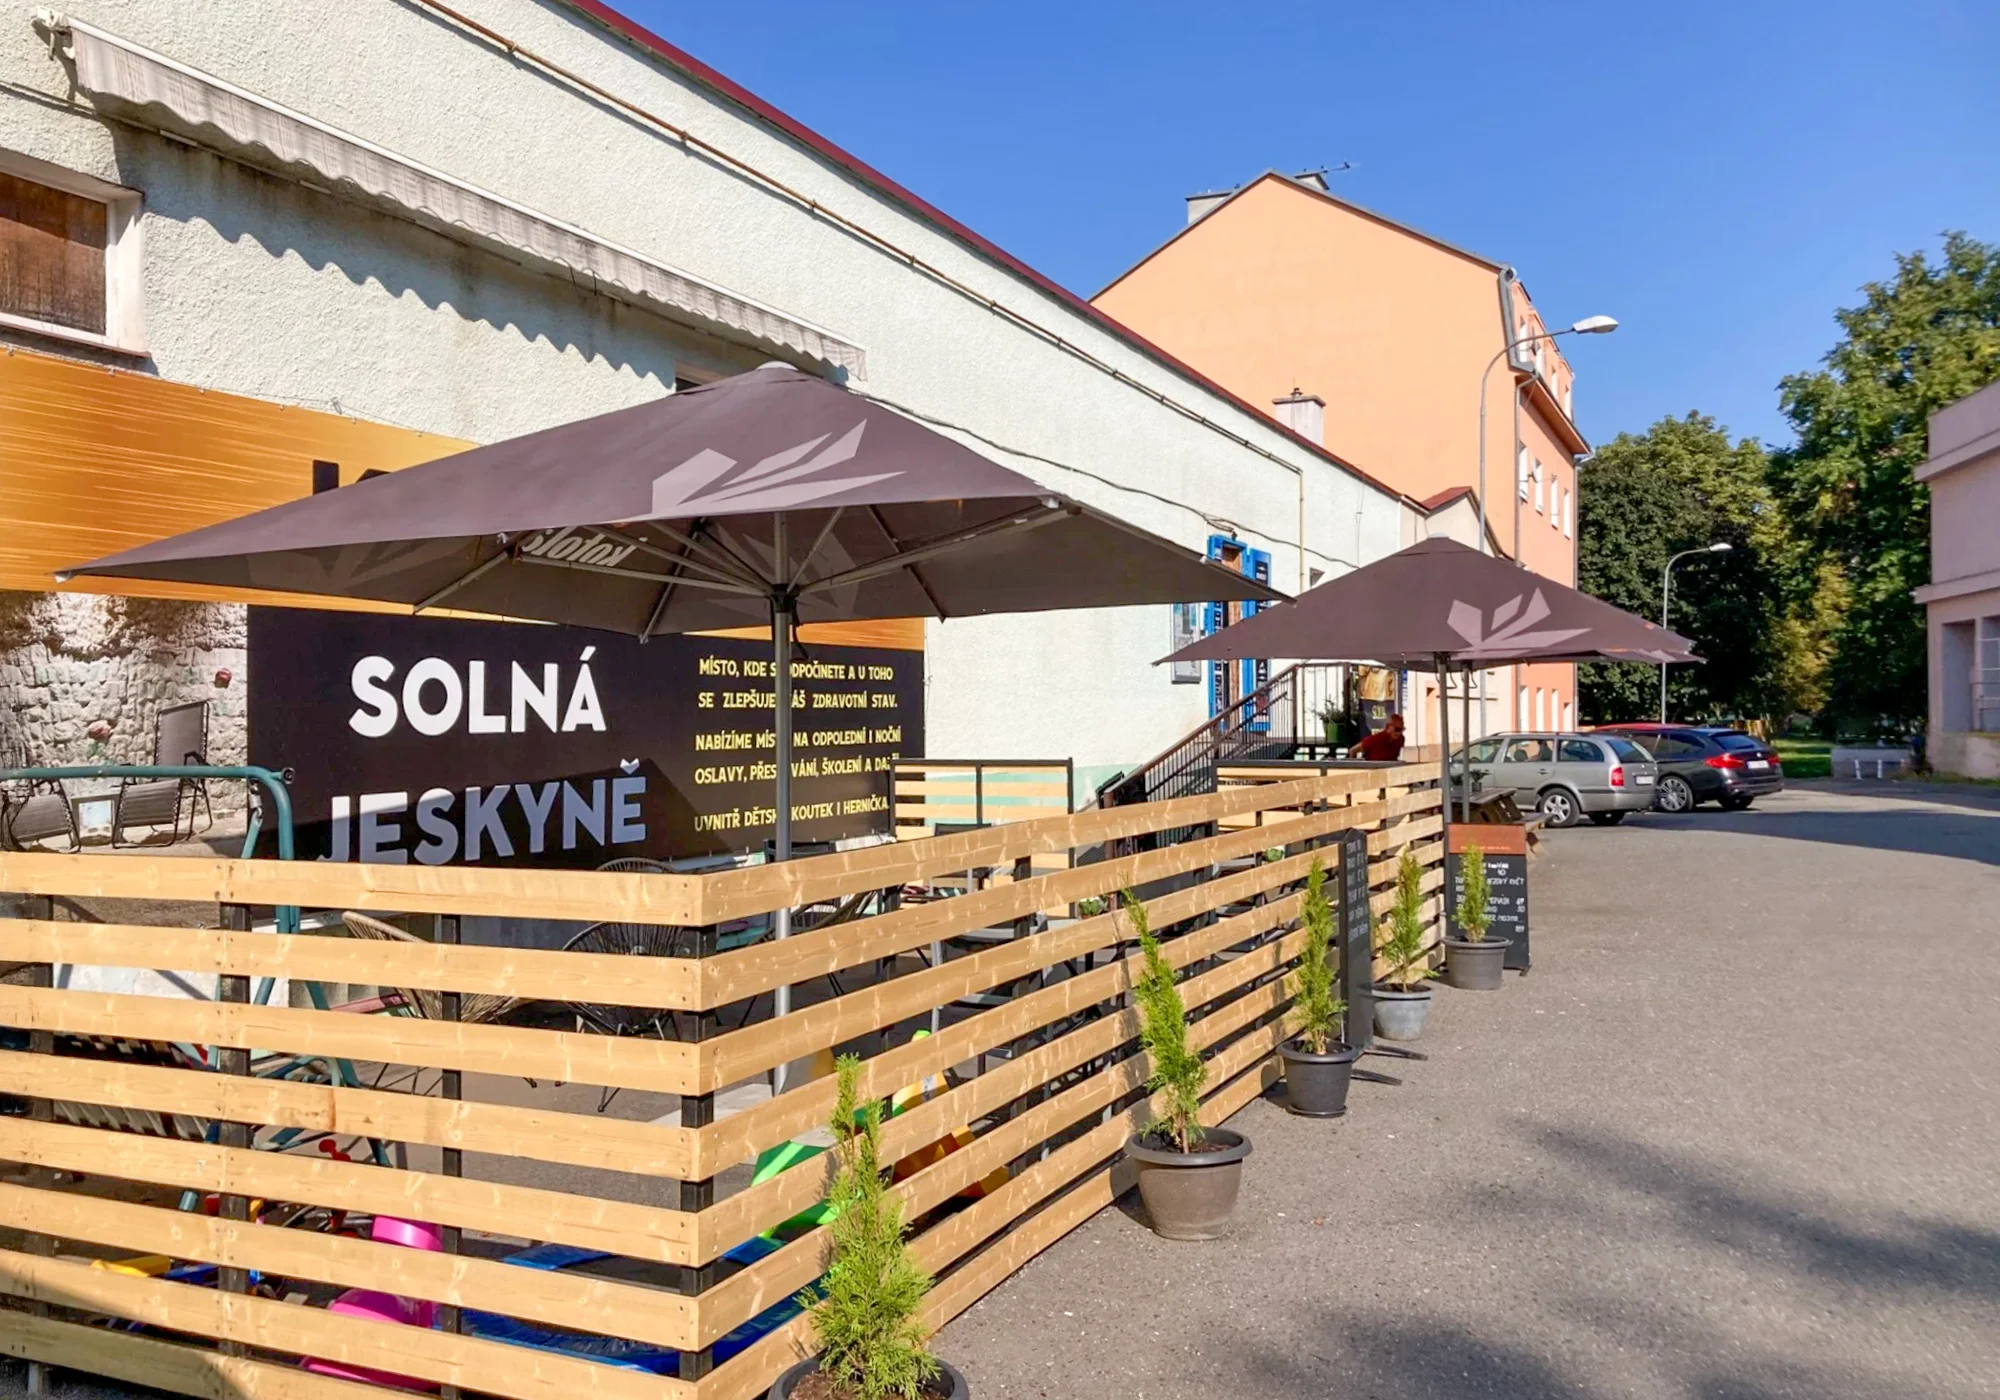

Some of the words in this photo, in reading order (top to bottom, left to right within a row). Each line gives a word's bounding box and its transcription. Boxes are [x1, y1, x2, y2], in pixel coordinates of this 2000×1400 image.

[699, 655, 740, 678] MÍSTO,
[743, 660, 767, 677] KDE
[790, 659, 845, 680] DPOČINETE
[848, 665, 856, 679] A
[858, 666, 866, 680] U
[868, 666, 894, 680] TOHO
[349, 646, 607, 738] SOLNÁ
[698, 692, 714, 708] SE
[723, 689, 776, 708] ZLEPŠUJE
[791, 689, 806, 708] ÁŠ
[812, 690, 867, 708] ZDRAVOTNÍ
[872, 693, 898, 708] STAV.
[695, 729, 753, 751] NABÍZÍME
[793, 731, 809, 747] NA
[812, 726, 867, 747] ODPOLEDNÍ
[875, 725, 902, 743] NOČNÍ
[694, 764, 748, 784] OSLAVY,
[821, 754, 862, 776] ŠKOLENÍ
[865, 759, 873, 772] A
[315, 758, 647, 865] JESKYNĚ
[694, 808, 740, 832] UVNITŘ
[791, 802, 834, 822] KOUTEK
[843, 794, 889, 815] HERNIČKA.
